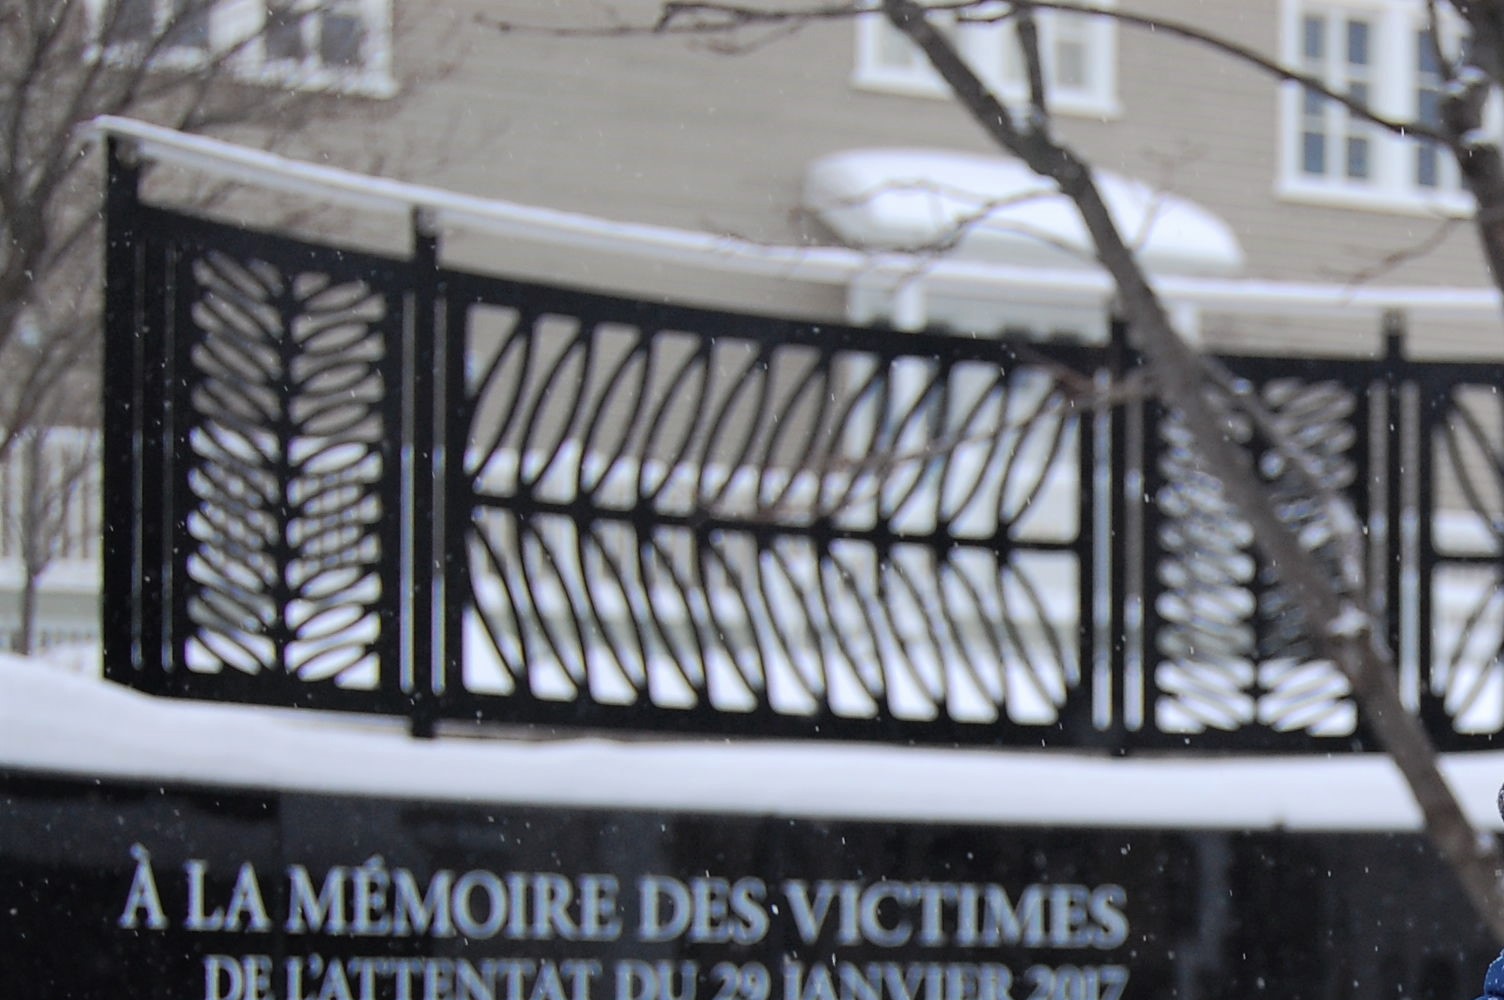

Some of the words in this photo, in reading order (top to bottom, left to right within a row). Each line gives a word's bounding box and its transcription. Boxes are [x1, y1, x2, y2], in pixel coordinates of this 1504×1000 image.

[118, 843, 167, 930] À
[183, 859, 271, 932] LA
[286, 854, 622, 942] MÉMOIRE
[638, 875, 770, 945] DES
[783, 879, 1130, 949] VICTIMES
